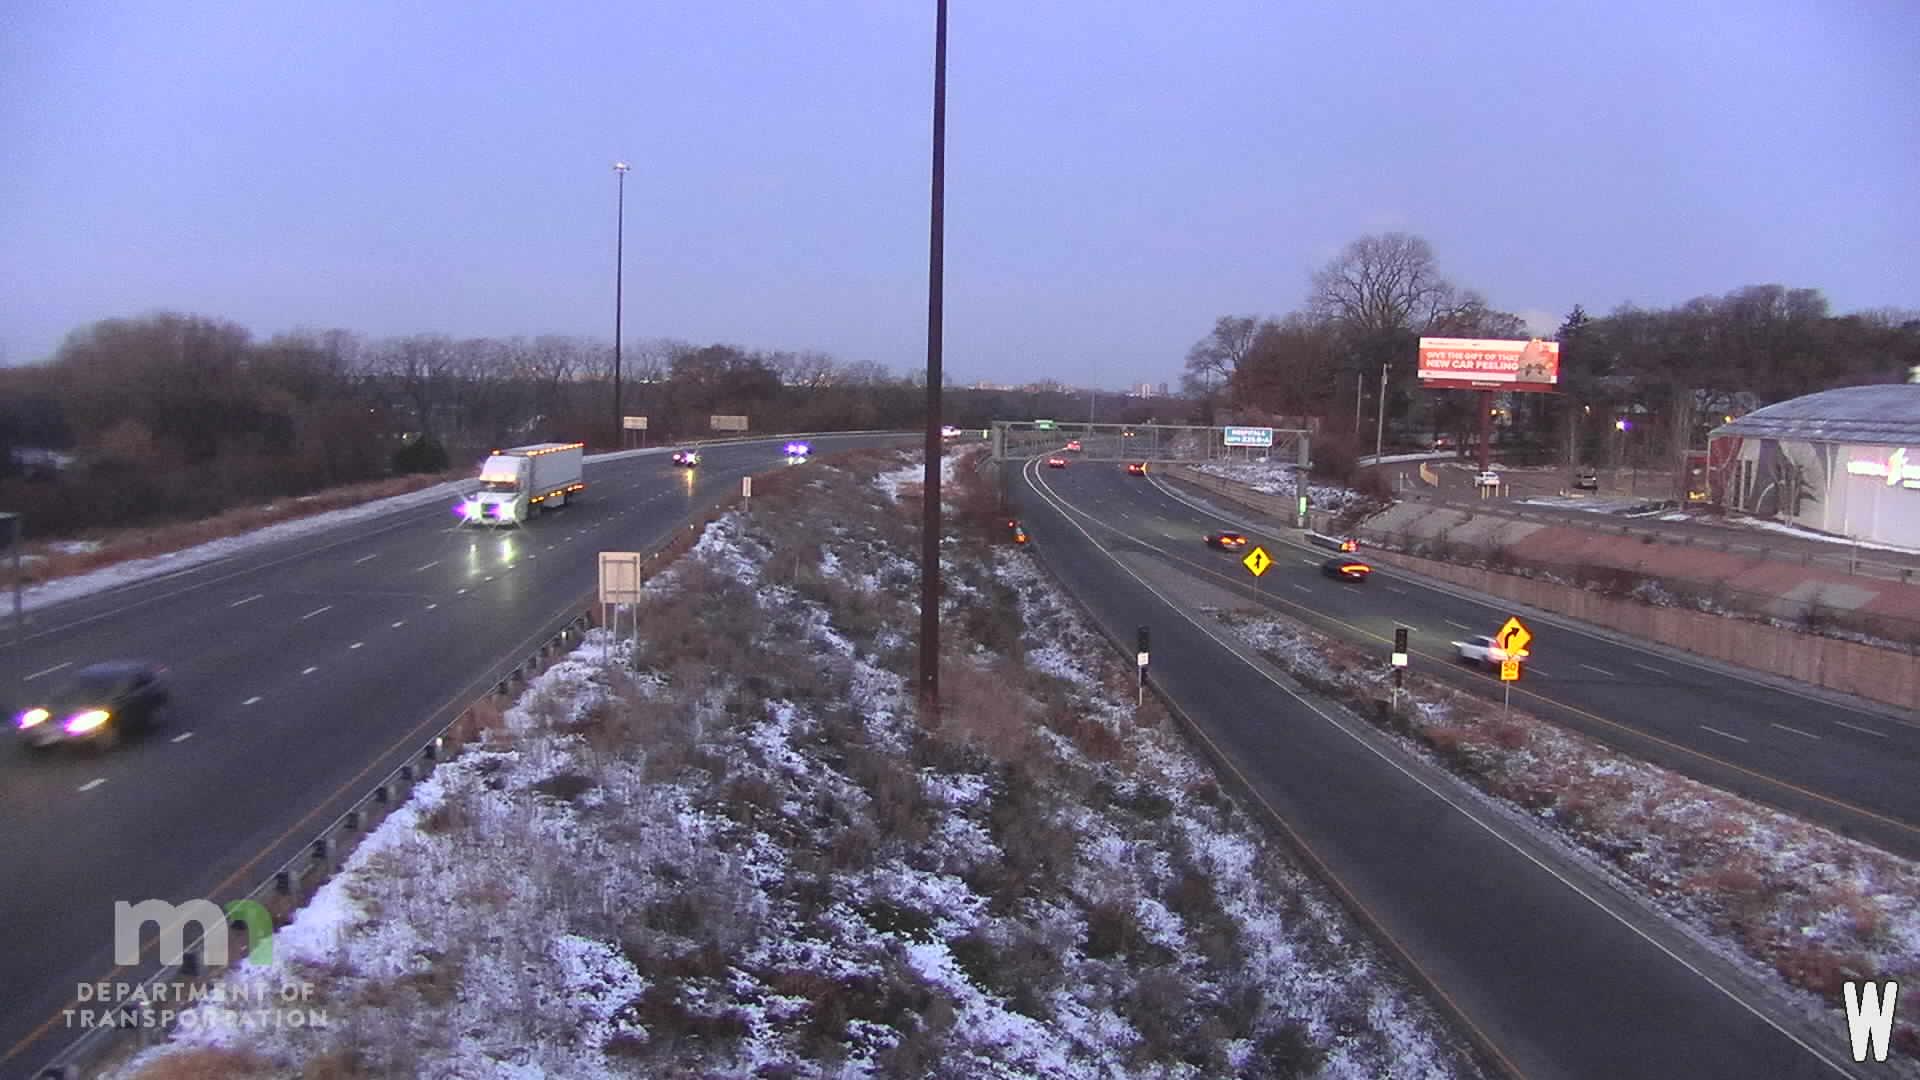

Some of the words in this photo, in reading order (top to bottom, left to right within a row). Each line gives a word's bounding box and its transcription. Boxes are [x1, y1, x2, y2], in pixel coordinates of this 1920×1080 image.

[1448, 352, 1464, 360] THE
[1426, 359, 1450, 368] NEW
[1452, 360, 1474, 369] CAR
[1476, 361, 1519, 370] FEELING
